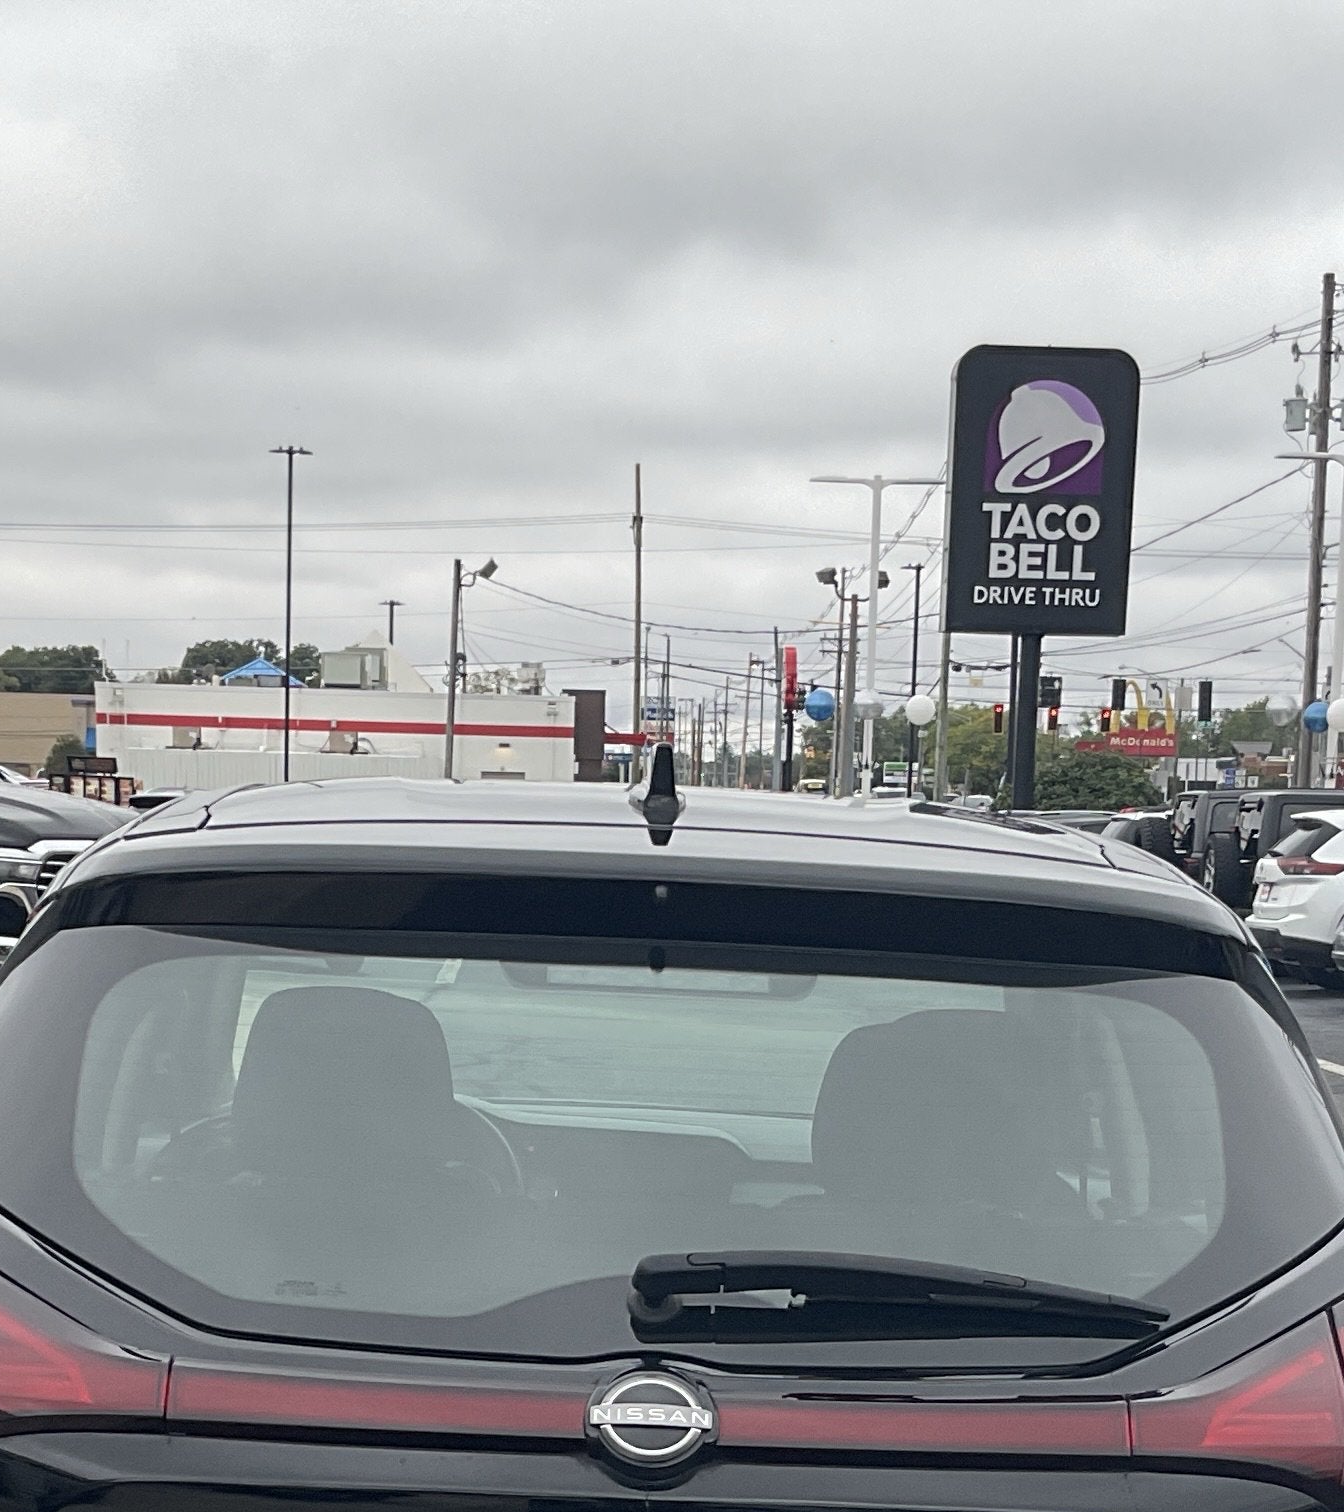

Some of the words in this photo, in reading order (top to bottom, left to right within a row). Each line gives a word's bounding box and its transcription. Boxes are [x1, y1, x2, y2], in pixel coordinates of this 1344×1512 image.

[982, 502, 1100, 541] TACO
[988, 543, 1096, 581] BELL
[973, 585, 1036, 605] DRIVE
[1042, 587, 1100, 607] THRU
[1109, 736, 1175, 747] McDonald's
[592, 1407, 710, 1427] NISSAN
